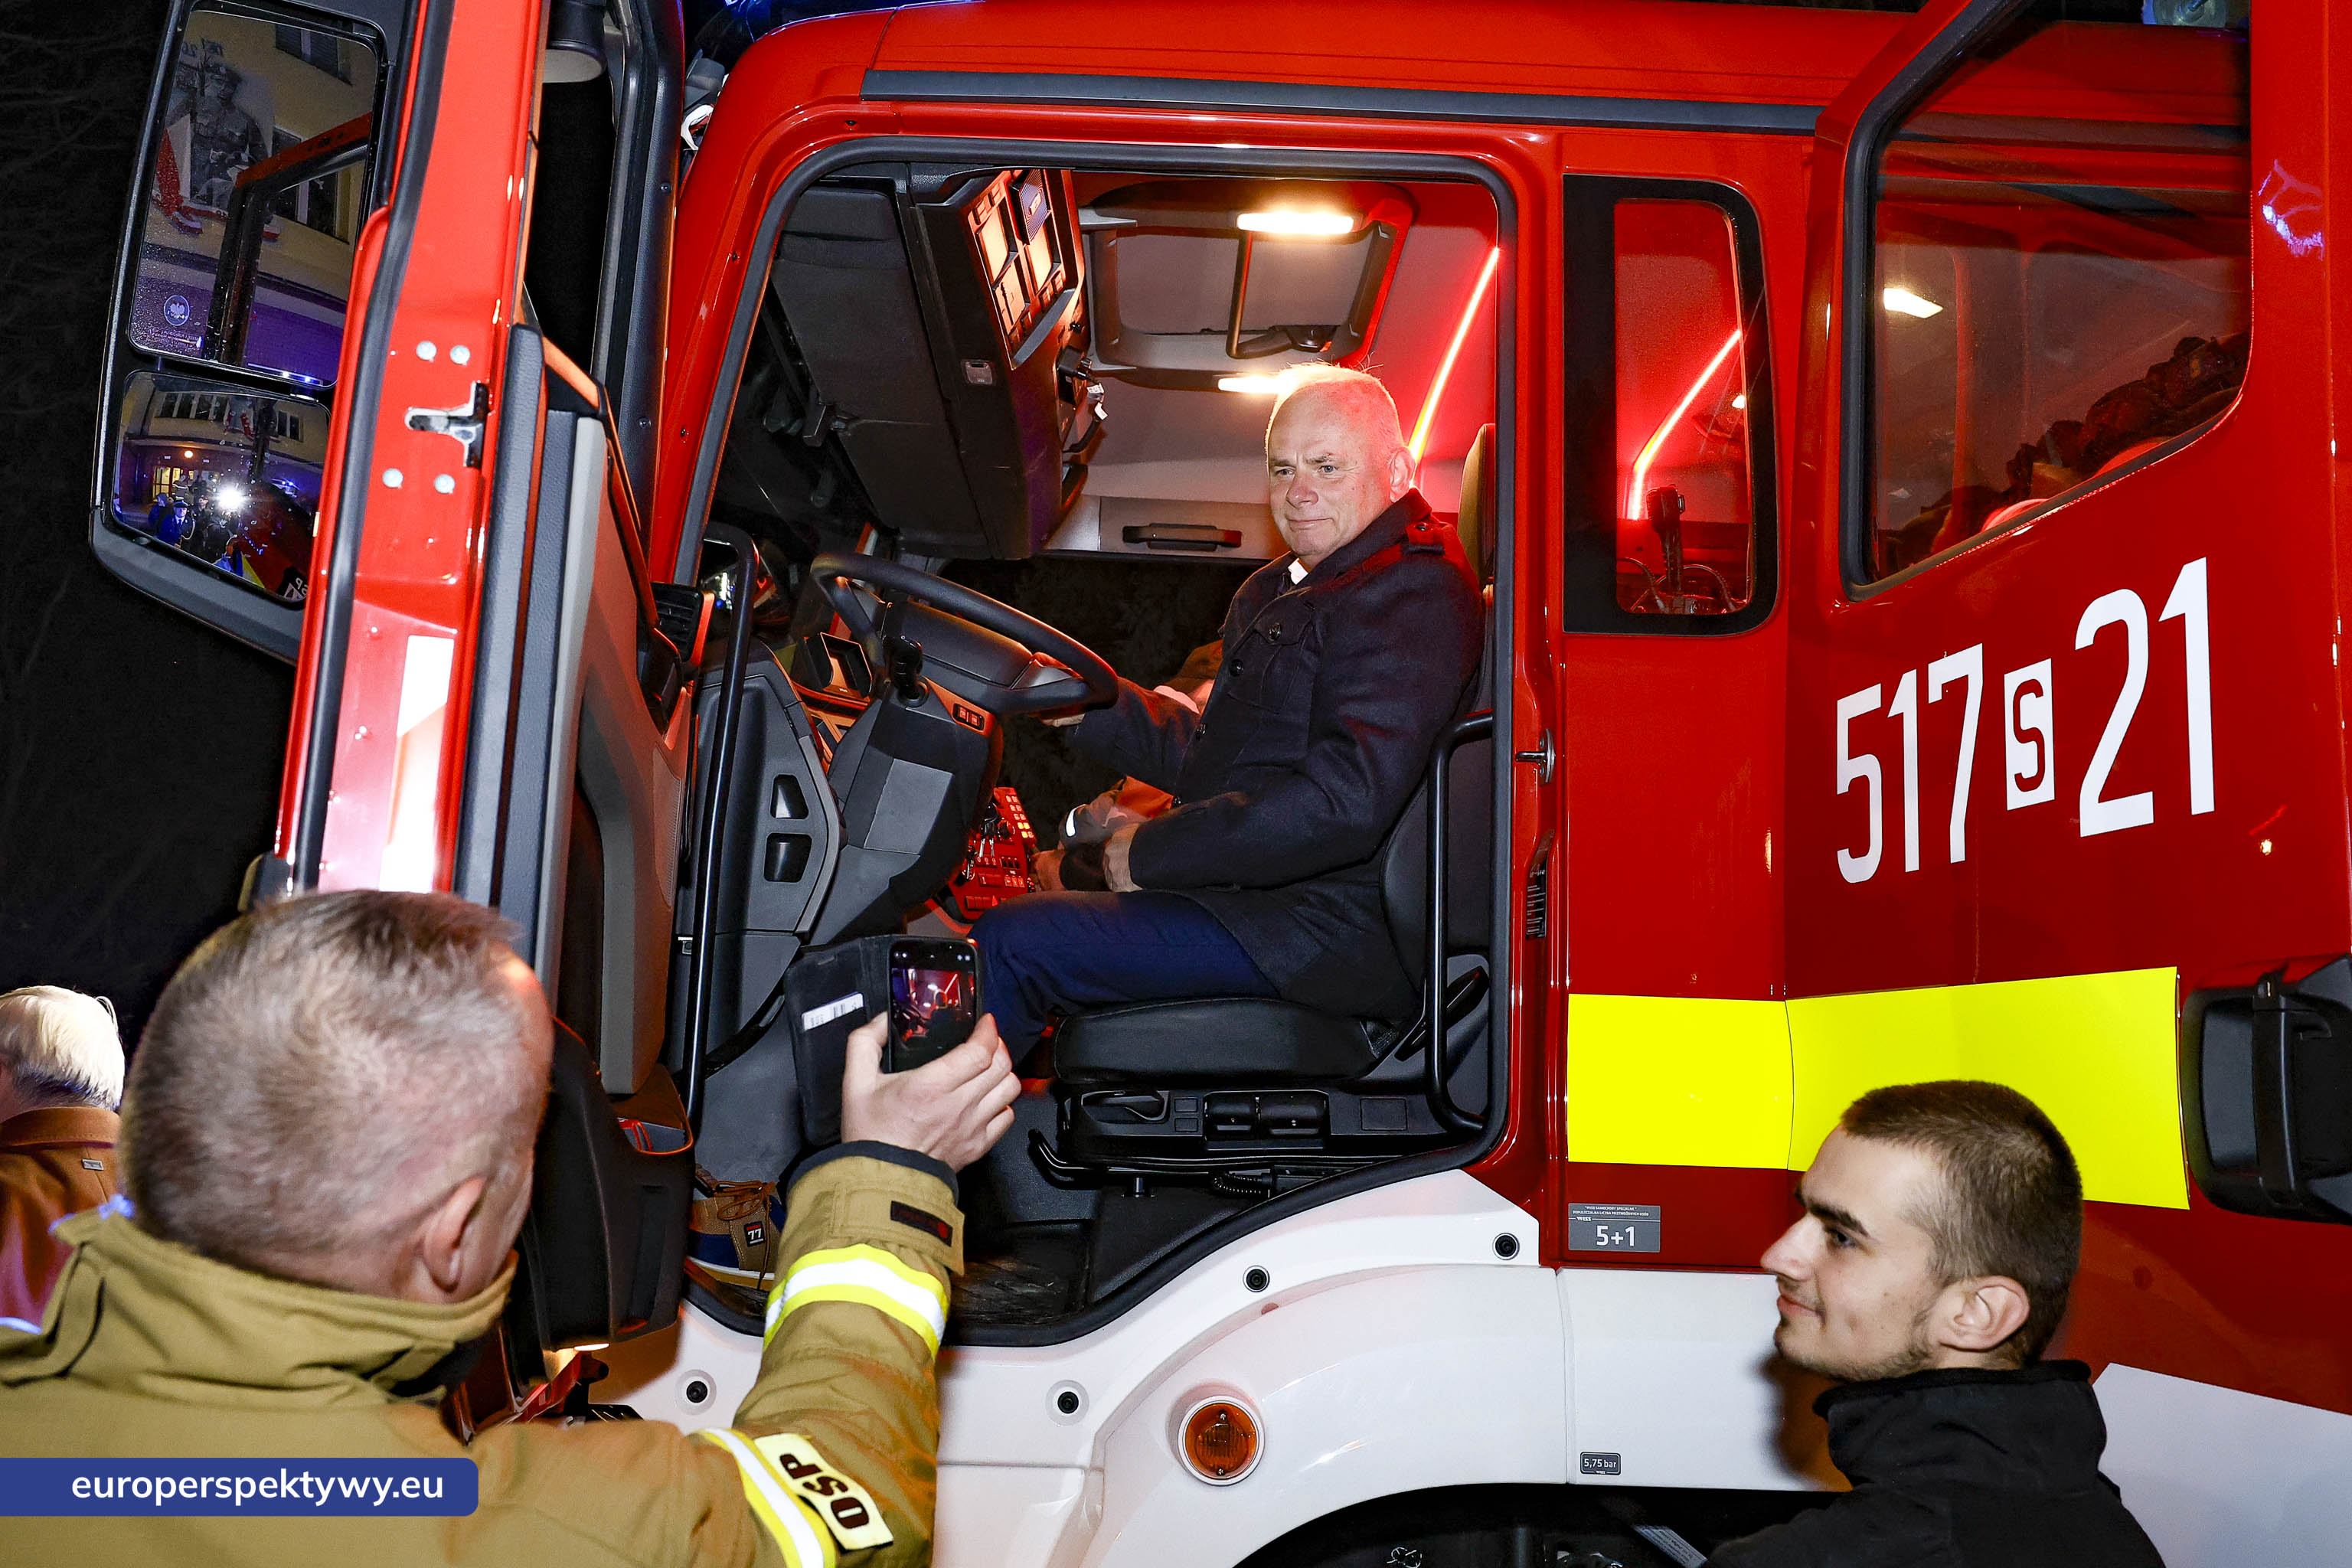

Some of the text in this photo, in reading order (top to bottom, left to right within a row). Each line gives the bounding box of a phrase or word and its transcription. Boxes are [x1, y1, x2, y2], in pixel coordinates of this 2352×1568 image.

[1837, 557, 2215, 884] 517 S 21
[747, 1228, 762, 1240] 77
[1596, 1225, 1635, 1246] 5+1
[1584, 1459, 1617, 1468] 5,75 bar
[779, 1454, 869, 1529] OSP
